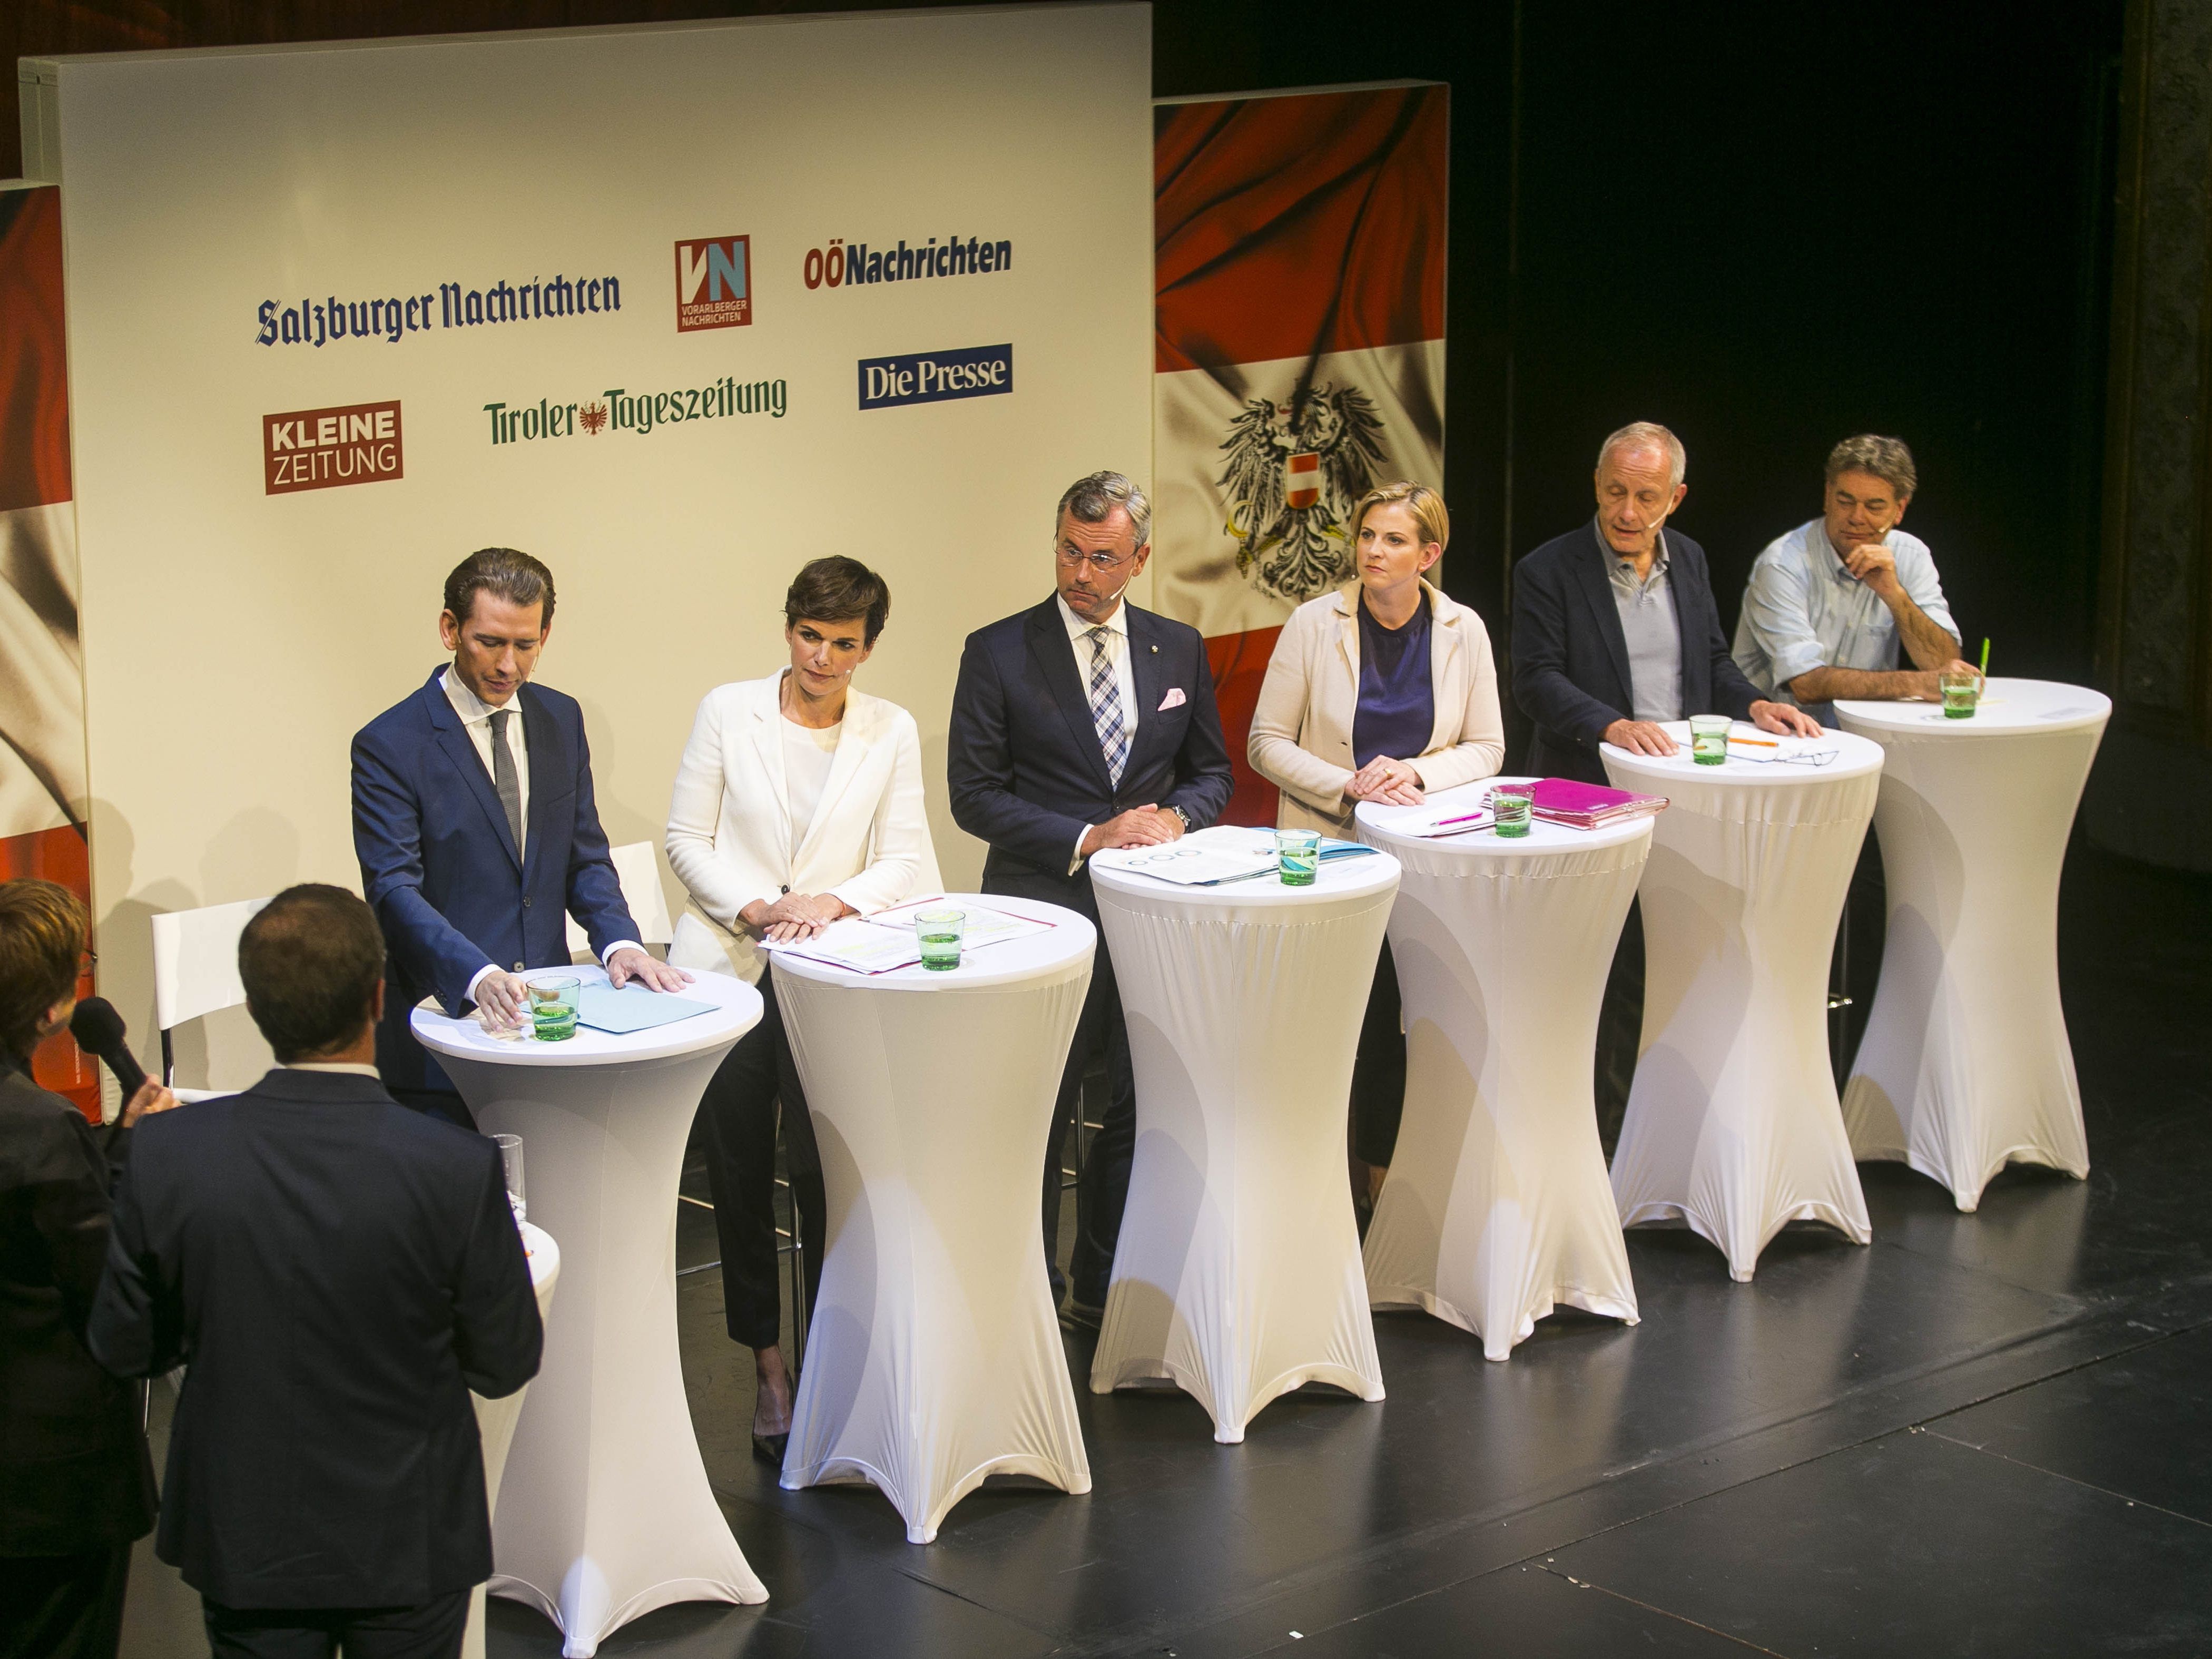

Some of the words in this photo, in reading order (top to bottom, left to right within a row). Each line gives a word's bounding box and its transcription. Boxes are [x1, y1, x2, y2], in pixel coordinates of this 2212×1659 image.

[680, 241, 746, 304] VN
[803, 235, 1012, 290] OÖNachrichten
[255, 295, 435, 348] Salzburger
[439, 274, 621, 328] Nachrichten
[682, 300, 747, 316] VORARLBERGER
[682, 312, 741, 327] NACHRICHTEN
[866, 364, 913, 400] Die
[917, 359, 1006, 394] Presse
[272, 410, 395, 451] KLEINE
[483, 398, 577, 445] Tiroler
[603, 376, 787, 434] Tageszeitung
[273, 443, 397, 485] ZEITUNG
